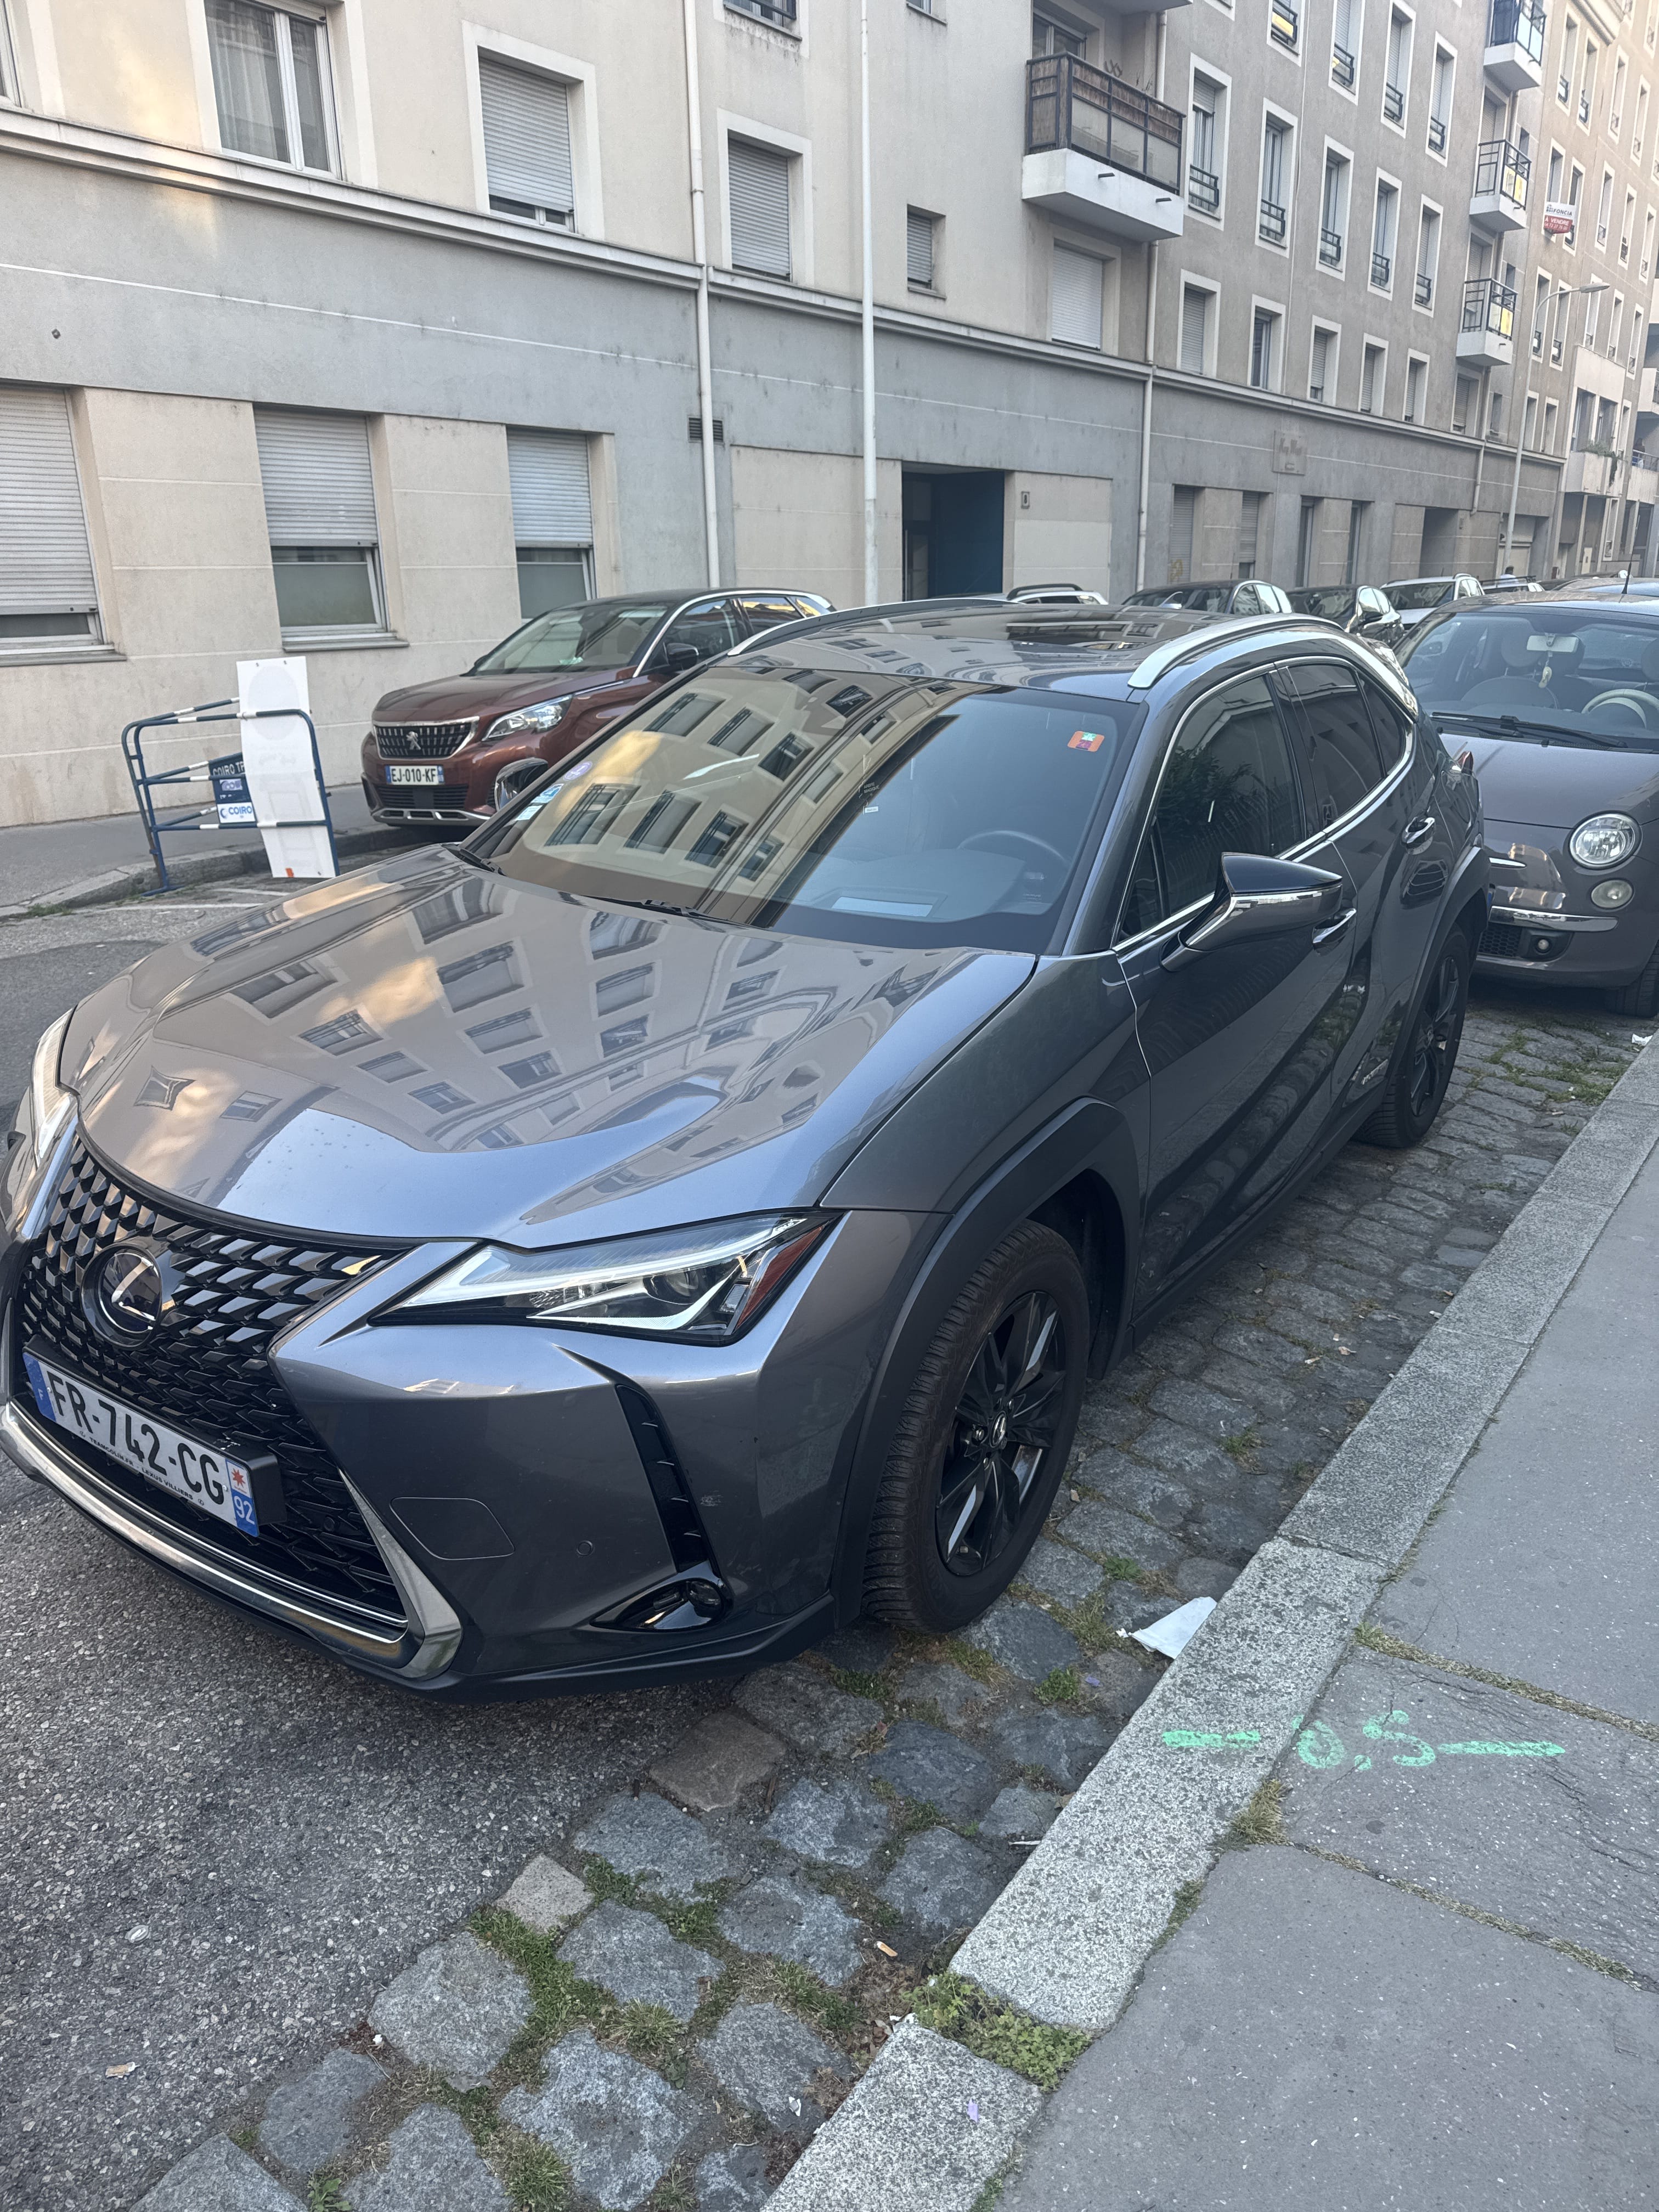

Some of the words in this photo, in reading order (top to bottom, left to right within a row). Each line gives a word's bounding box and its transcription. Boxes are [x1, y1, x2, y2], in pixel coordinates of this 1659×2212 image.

[392, 769, 436, 782] EJ-010-KF
[228, 806, 252, 815] COIRO
[46, 1370, 224, 1506] FR-742-CG
[142, 1467, 163, 1483] LEXUS
[164, 1480, 194, 1500] VILLIERS
[234, 1496, 255, 1525] 92
